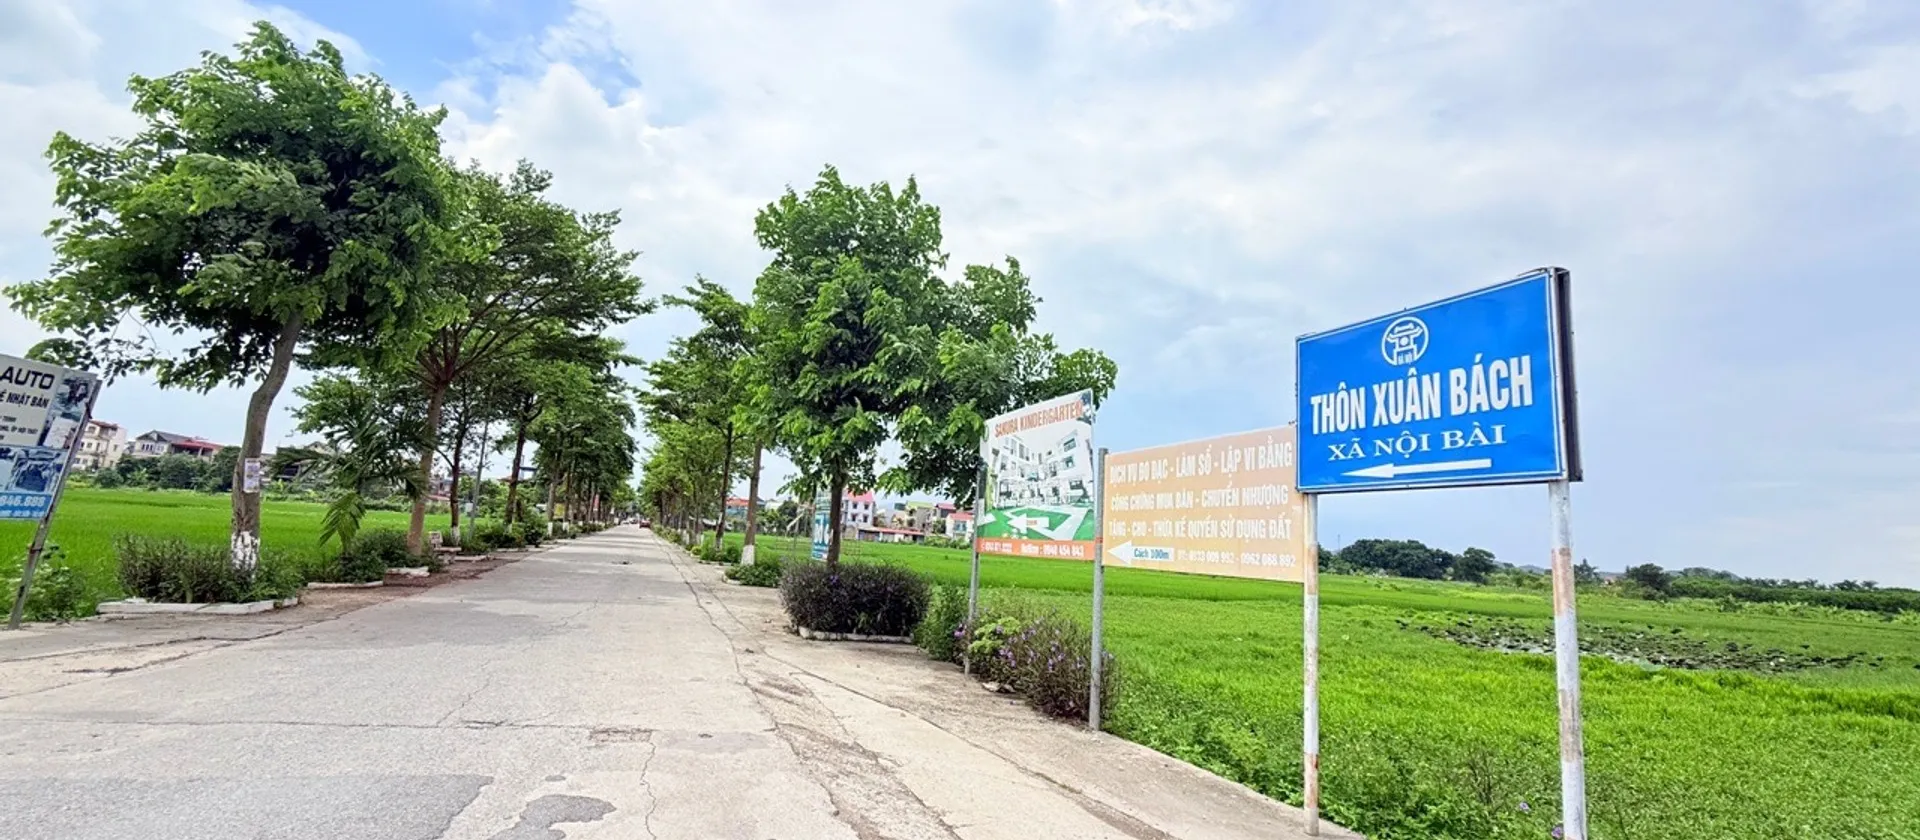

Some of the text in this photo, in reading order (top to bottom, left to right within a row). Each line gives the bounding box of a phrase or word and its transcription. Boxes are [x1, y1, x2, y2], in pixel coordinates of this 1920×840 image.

[0, 366, 55, 390] AUTO
[1311, 353, 1533, 434] THÔN XUÂN BÁCH
[1020, 400, 1084, 431] KINDERGARTEN
[1328, 421, 1507, 461] XÃ NỘI BÀI
[1244, 446, 1256, 472] VI
[1156, 492, 1174, 510] MUA
